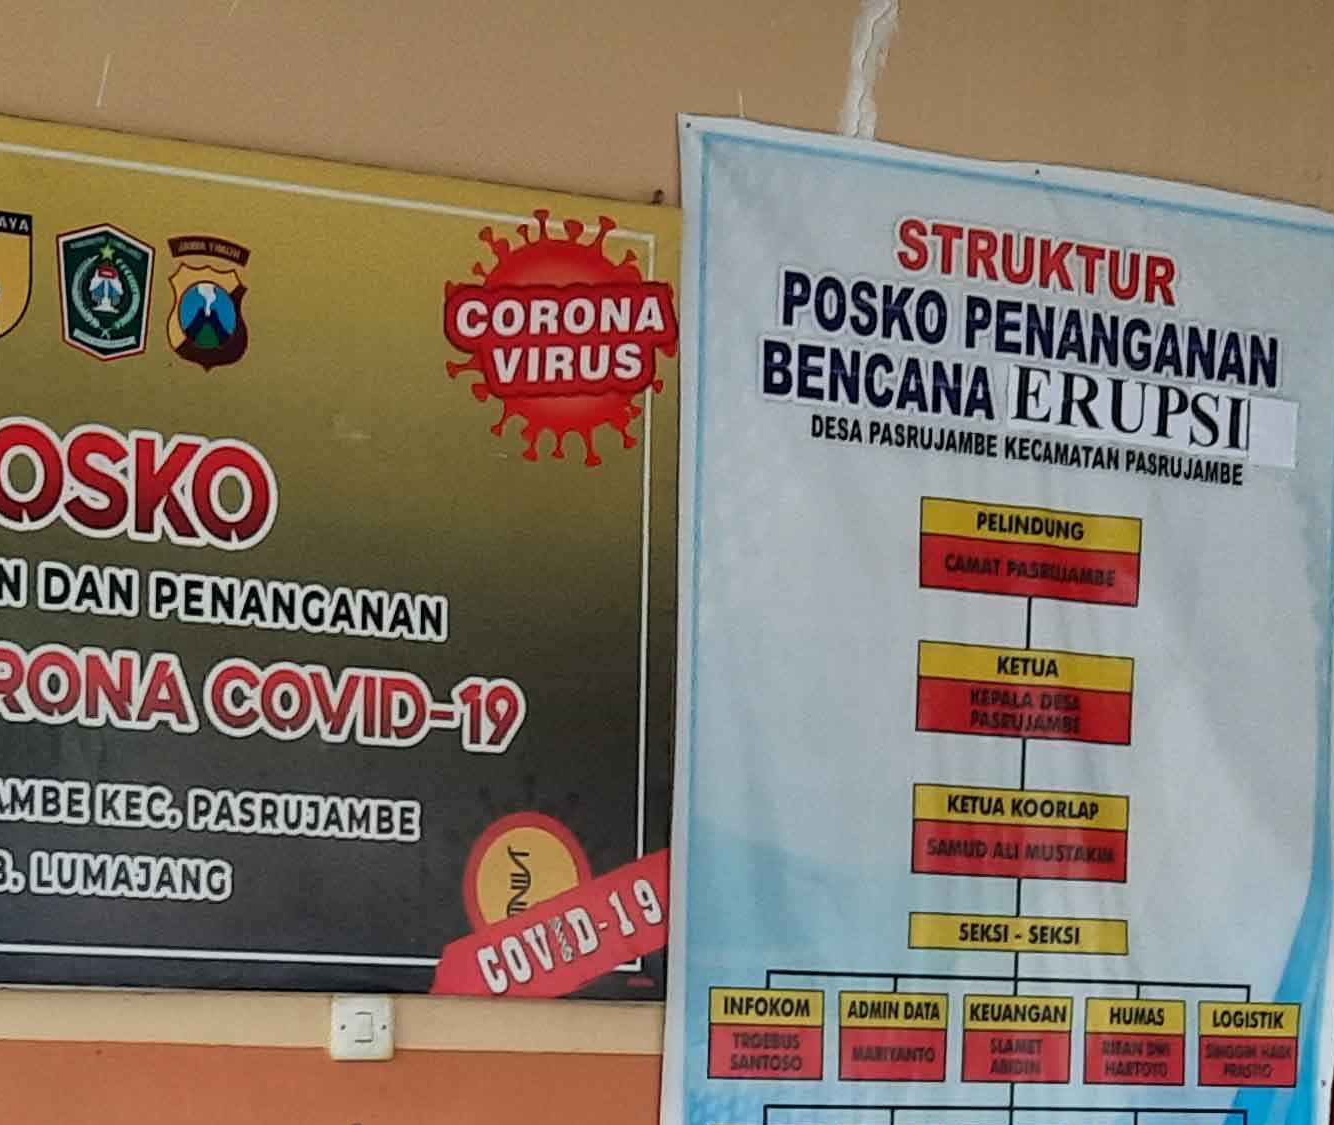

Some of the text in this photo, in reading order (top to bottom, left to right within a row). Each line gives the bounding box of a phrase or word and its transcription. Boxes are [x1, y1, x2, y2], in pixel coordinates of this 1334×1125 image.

[897, 218, 1177, 306] STRUKTUR
[455, 296, 665, 338] CORONA
[781, 270, 1280, 388] POSKO PENANGANAN
[491, 343, 644, 384] VIRUS
[762, 340, 1251, 450] BENCANA ERUPSI
[812, 413, 1244, 486] DESA PASRUJAMBE KECAMATAN PASRUJAMBE
[977, 511, 1084, 541] PELINDUNG
[944, 553, 1000, 576] CAMAT
[38, 560, 139, 617] DAN
[149, 571, 448, 641] PENANGANAN
[997, 655, 1059, 678] KETUA
[203, 657, 526, 753] COVID-19
[971, 688, 1033, 708] KEPALA
[95, 783, 183, 829] KEC.
[188, 789, 421, 842] PASRUJAMBE
[947, 794, 1099, 820] KETUA KOORLAP
[30, 851, 233, 901] LUMAJANG
[958, 923, 1009, 943] SEKSI
[1028, 925, 1080, 945] SEKSI
[723, 996, 811, 1017] INFOKOM
[847, 1000, 940, 1020] ADMIN DATA
[969, 1003, 1067, 1023] KEUANGAN
[1109, 1007, 1165, 1026] HUMAS
[1212, 1009, 1284, 1029] LOGISTIK
[730, 1054, 803, 1072] SANTOSO
